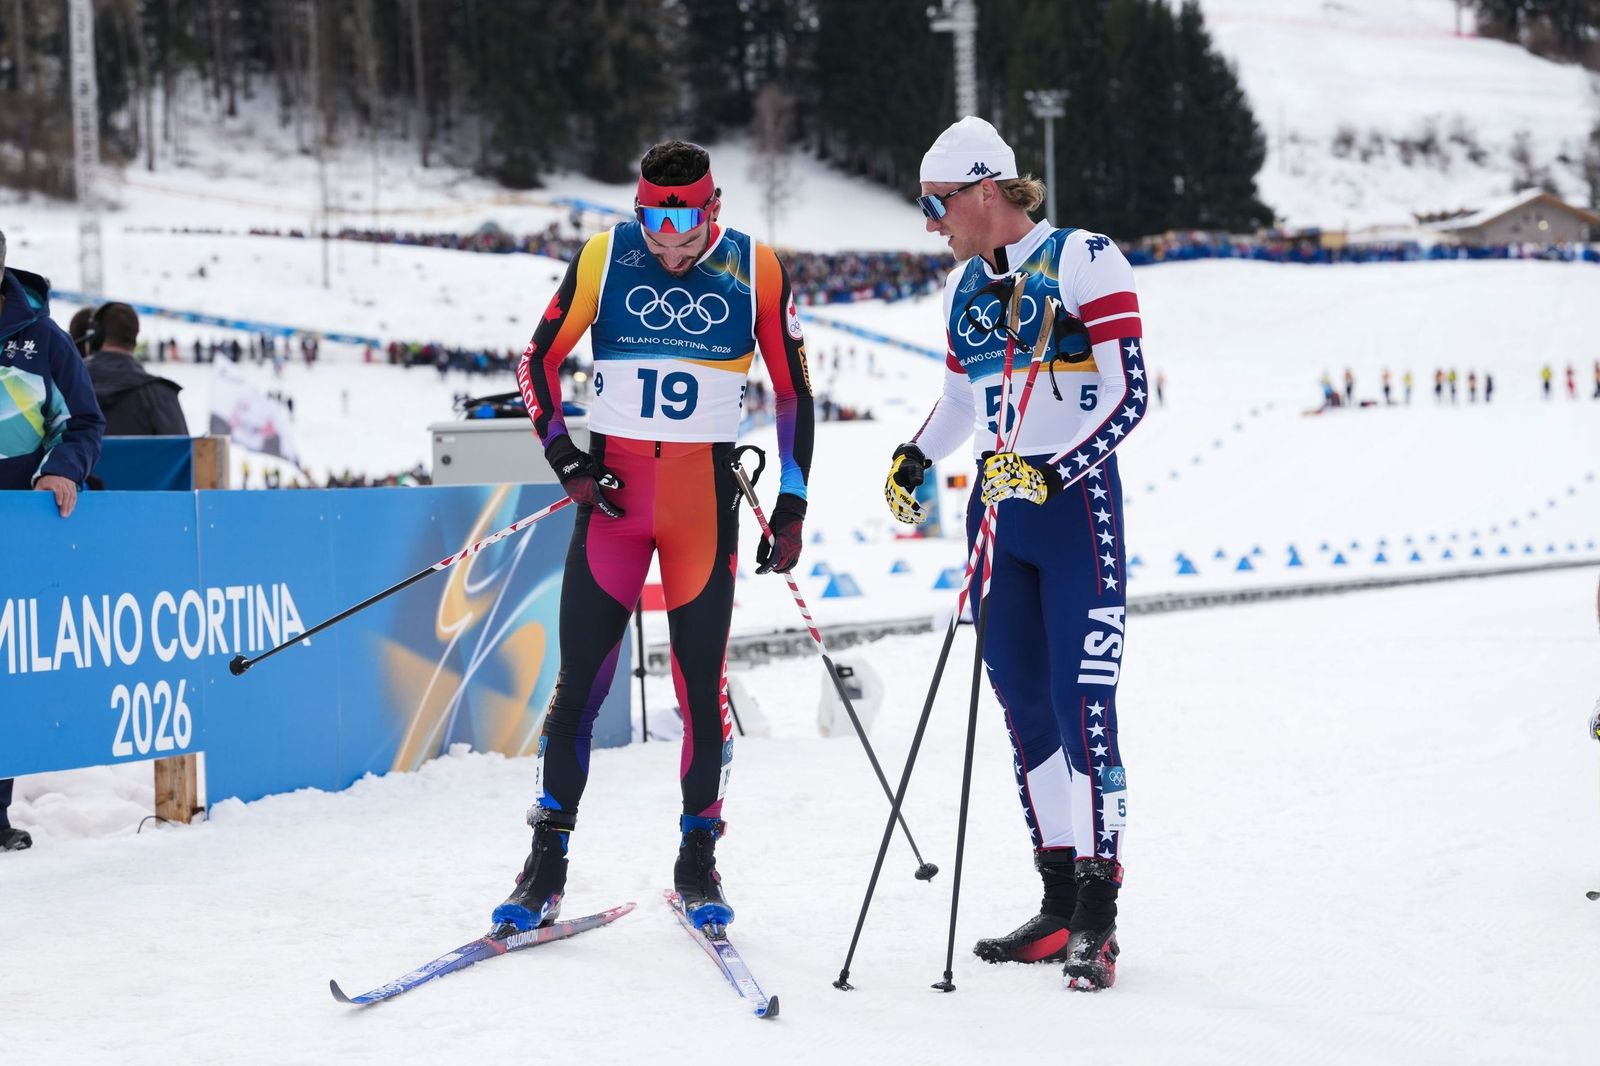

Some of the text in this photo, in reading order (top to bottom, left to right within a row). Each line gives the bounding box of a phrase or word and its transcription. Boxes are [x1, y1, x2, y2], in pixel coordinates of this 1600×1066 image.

[617, 336, 732, 354] MILANO CORTINA 2026
[518, 343, 538, 424] CANADA
[637, 367, 699, 421] 19
[985, 383, 1016, 435] 5
[1079, 385, 1098, 411] 5
[151, 582, 312, 663] CORTINA
[1077, 605, 1126, 686] USA
[110, 679, 193, 758] 2026
[1117, 798, 1127, 818] 5
[506, 928, 539, 950] SALOMON
